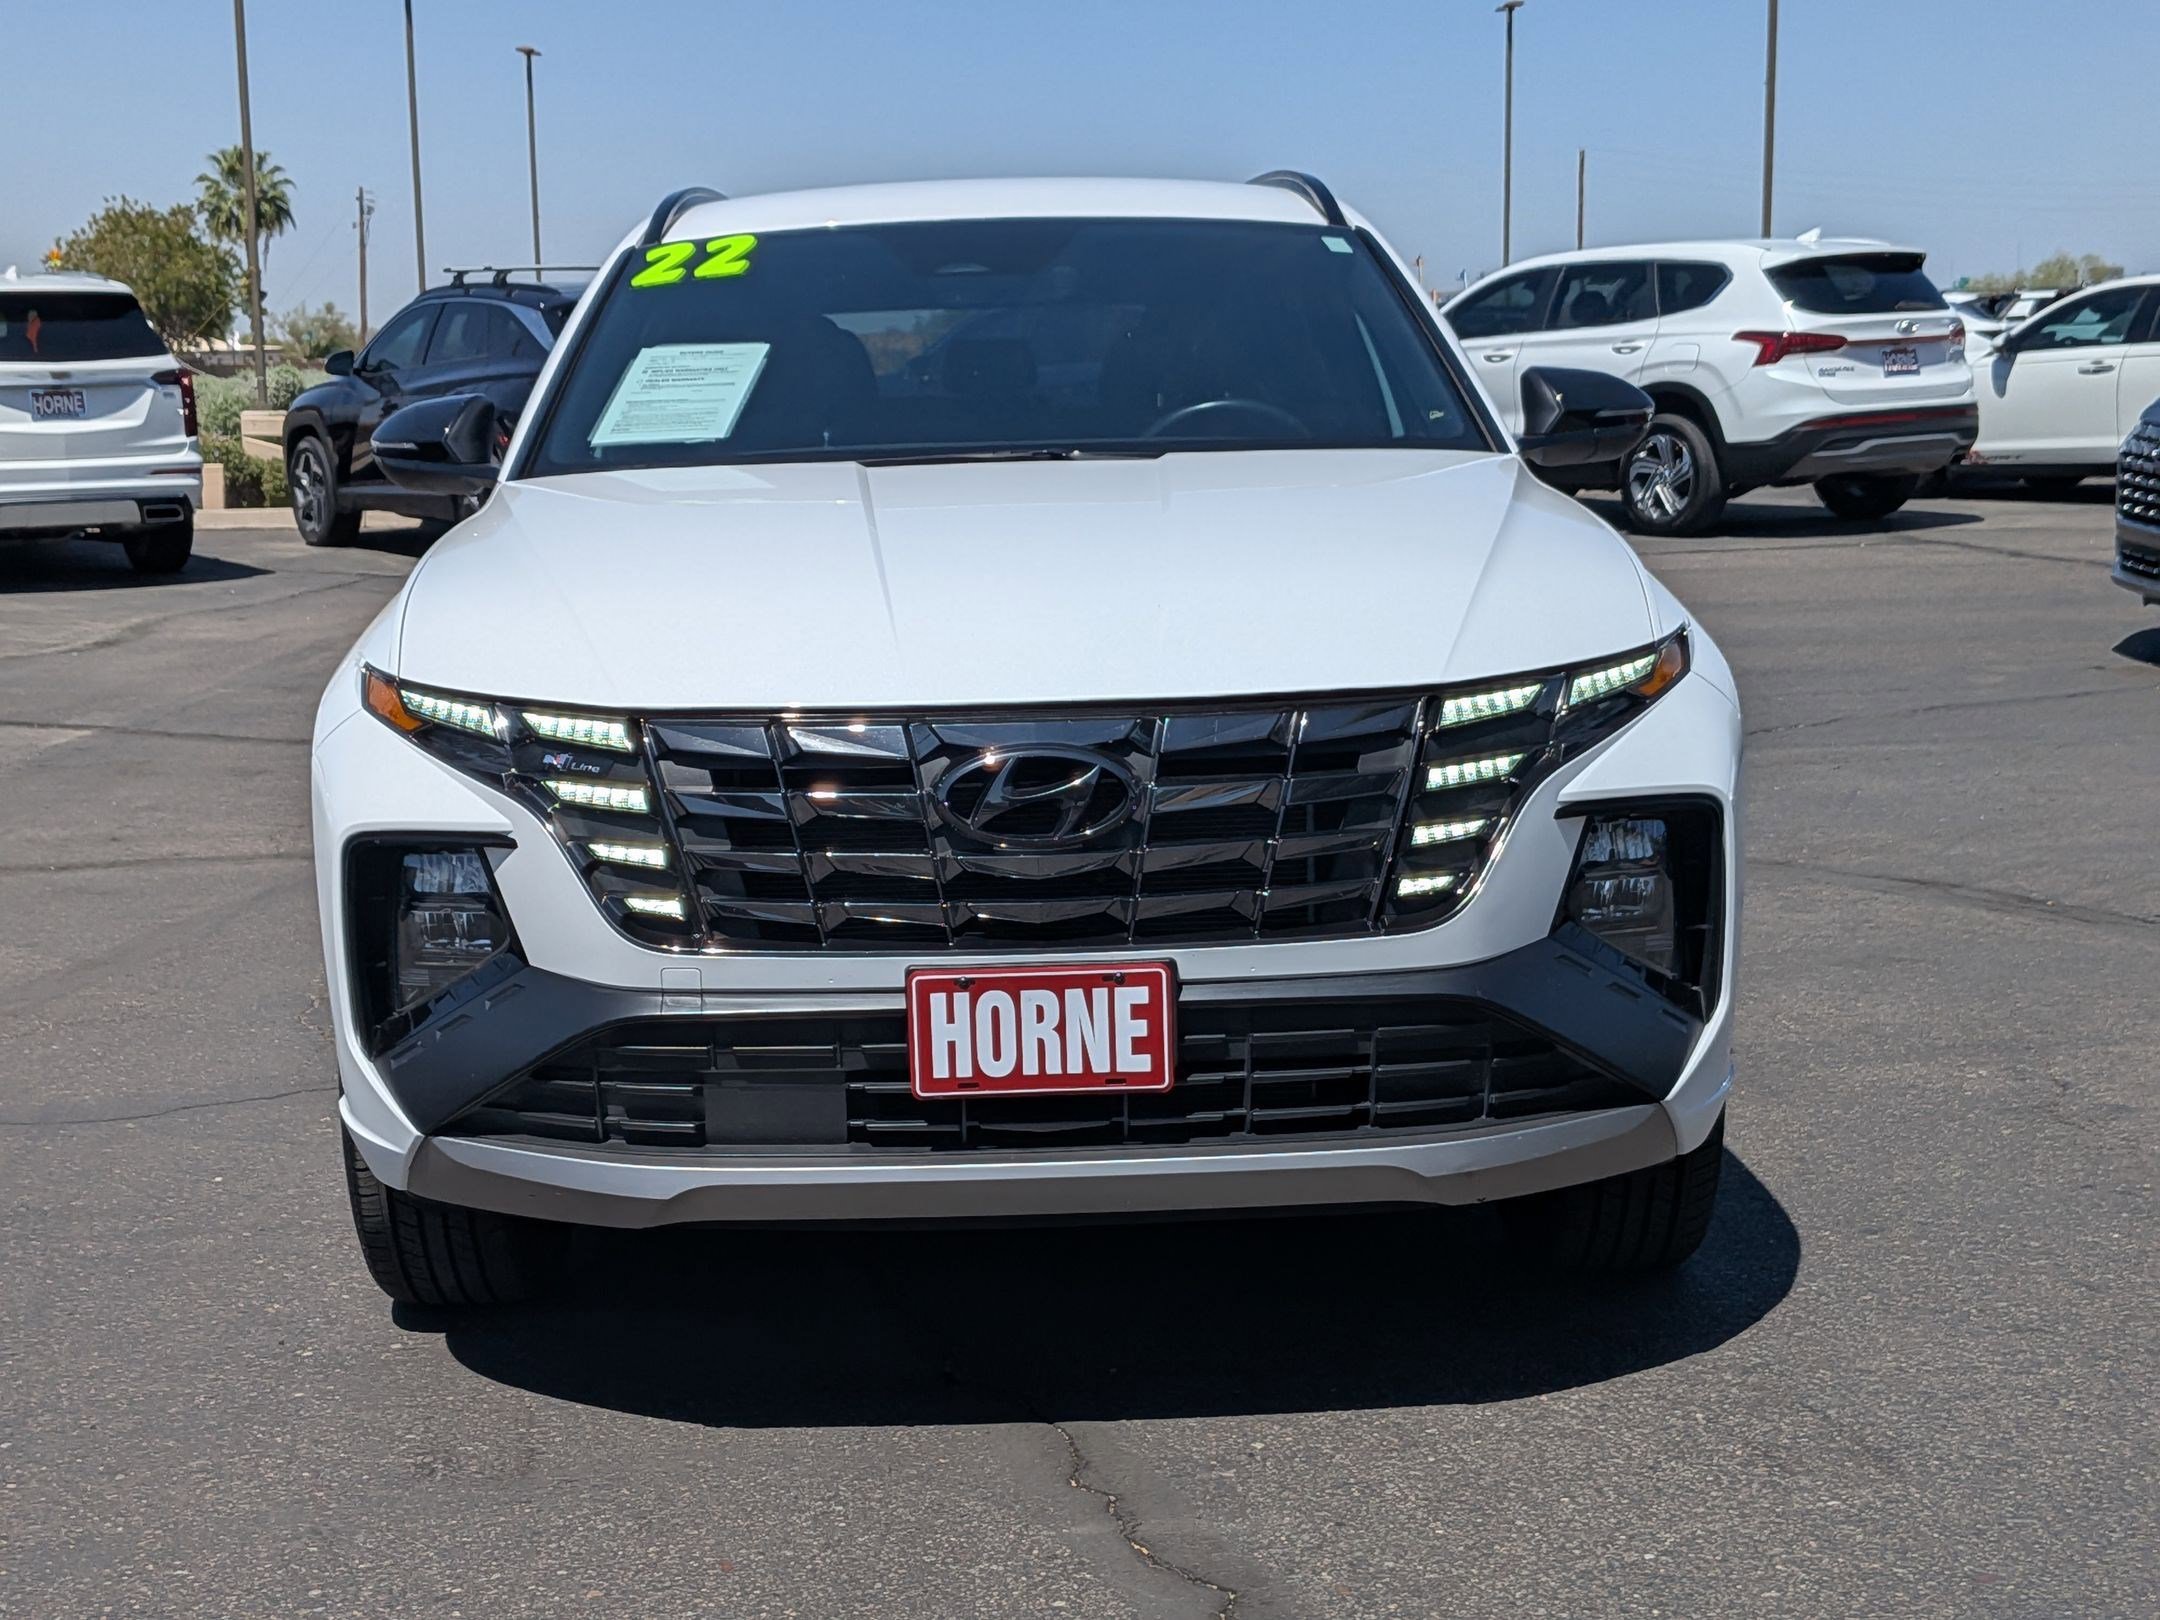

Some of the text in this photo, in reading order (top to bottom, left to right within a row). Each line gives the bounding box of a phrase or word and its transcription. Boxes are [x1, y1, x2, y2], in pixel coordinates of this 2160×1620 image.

[630, 233, 758, 288] 22
[32, 395, 83, 416] HORNE
[929, 985, 1152, 1079] HORNE
